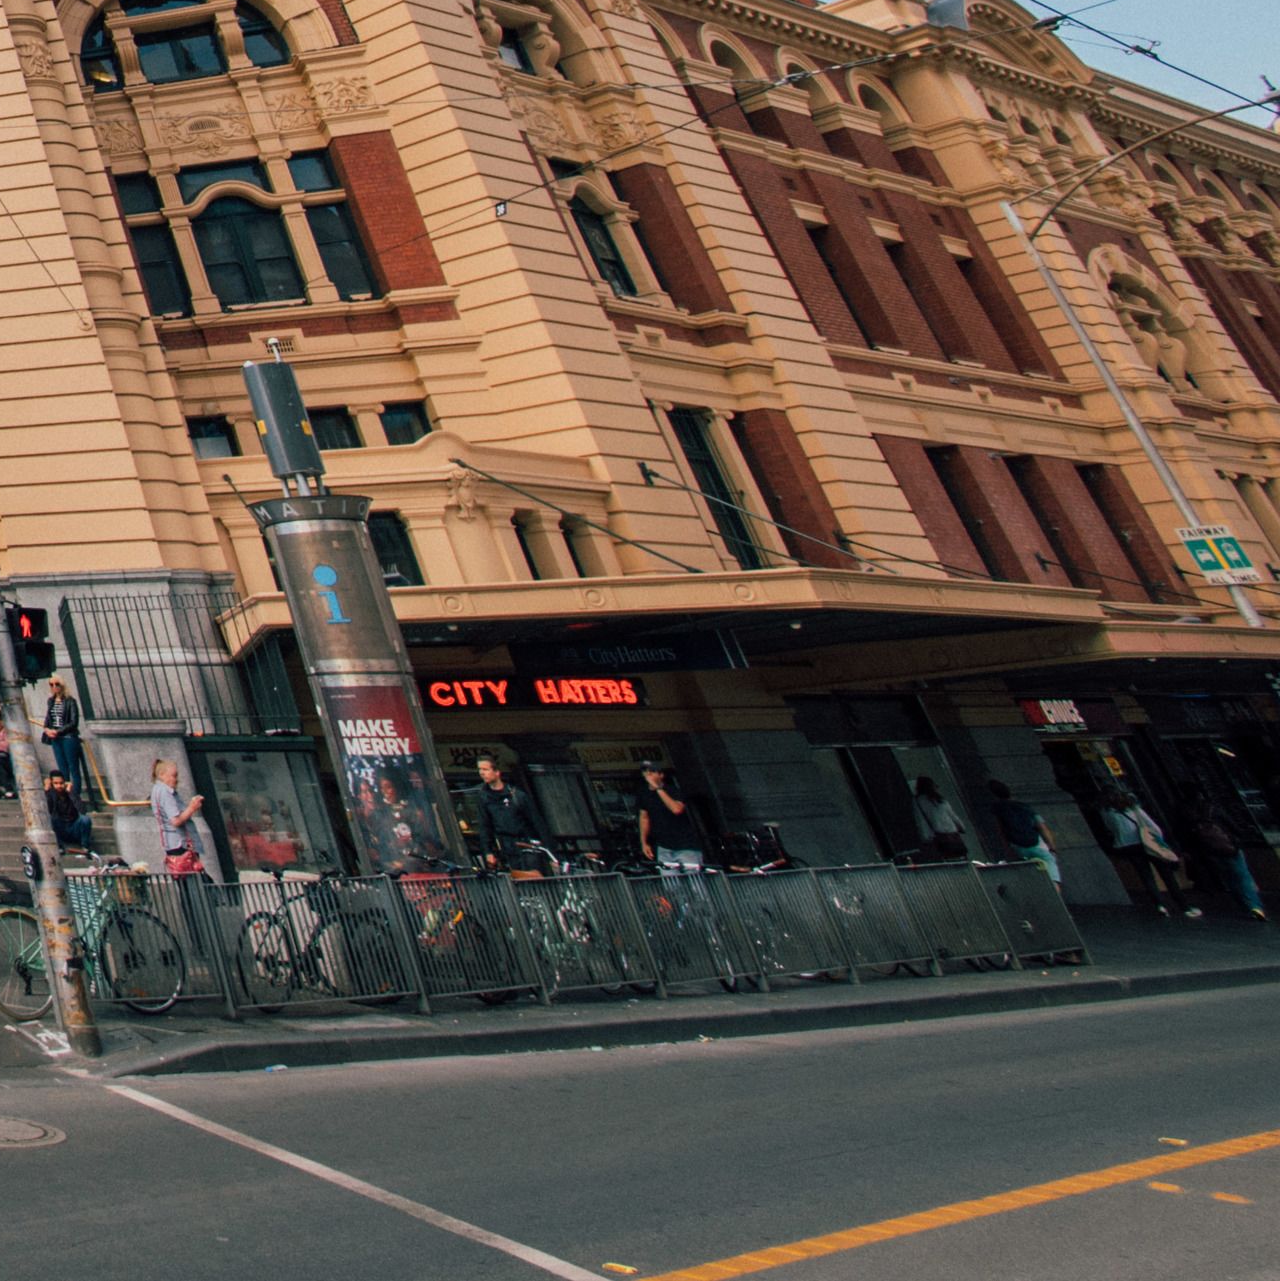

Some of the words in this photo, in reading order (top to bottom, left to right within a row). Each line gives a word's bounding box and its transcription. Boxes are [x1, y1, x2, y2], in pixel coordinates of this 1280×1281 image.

[1179, 526, 1225, 539] FAIRWAY
[1210, 576, 1226, 584] ALL
[1231, 574, 1260, 584] TIMES
[430, 680, 507, 707] CITY
[534, 679, 638, 705] HATTERS
[338, 719, 397, 737] MAKE
[343, 737, 410, 756] MERRY
